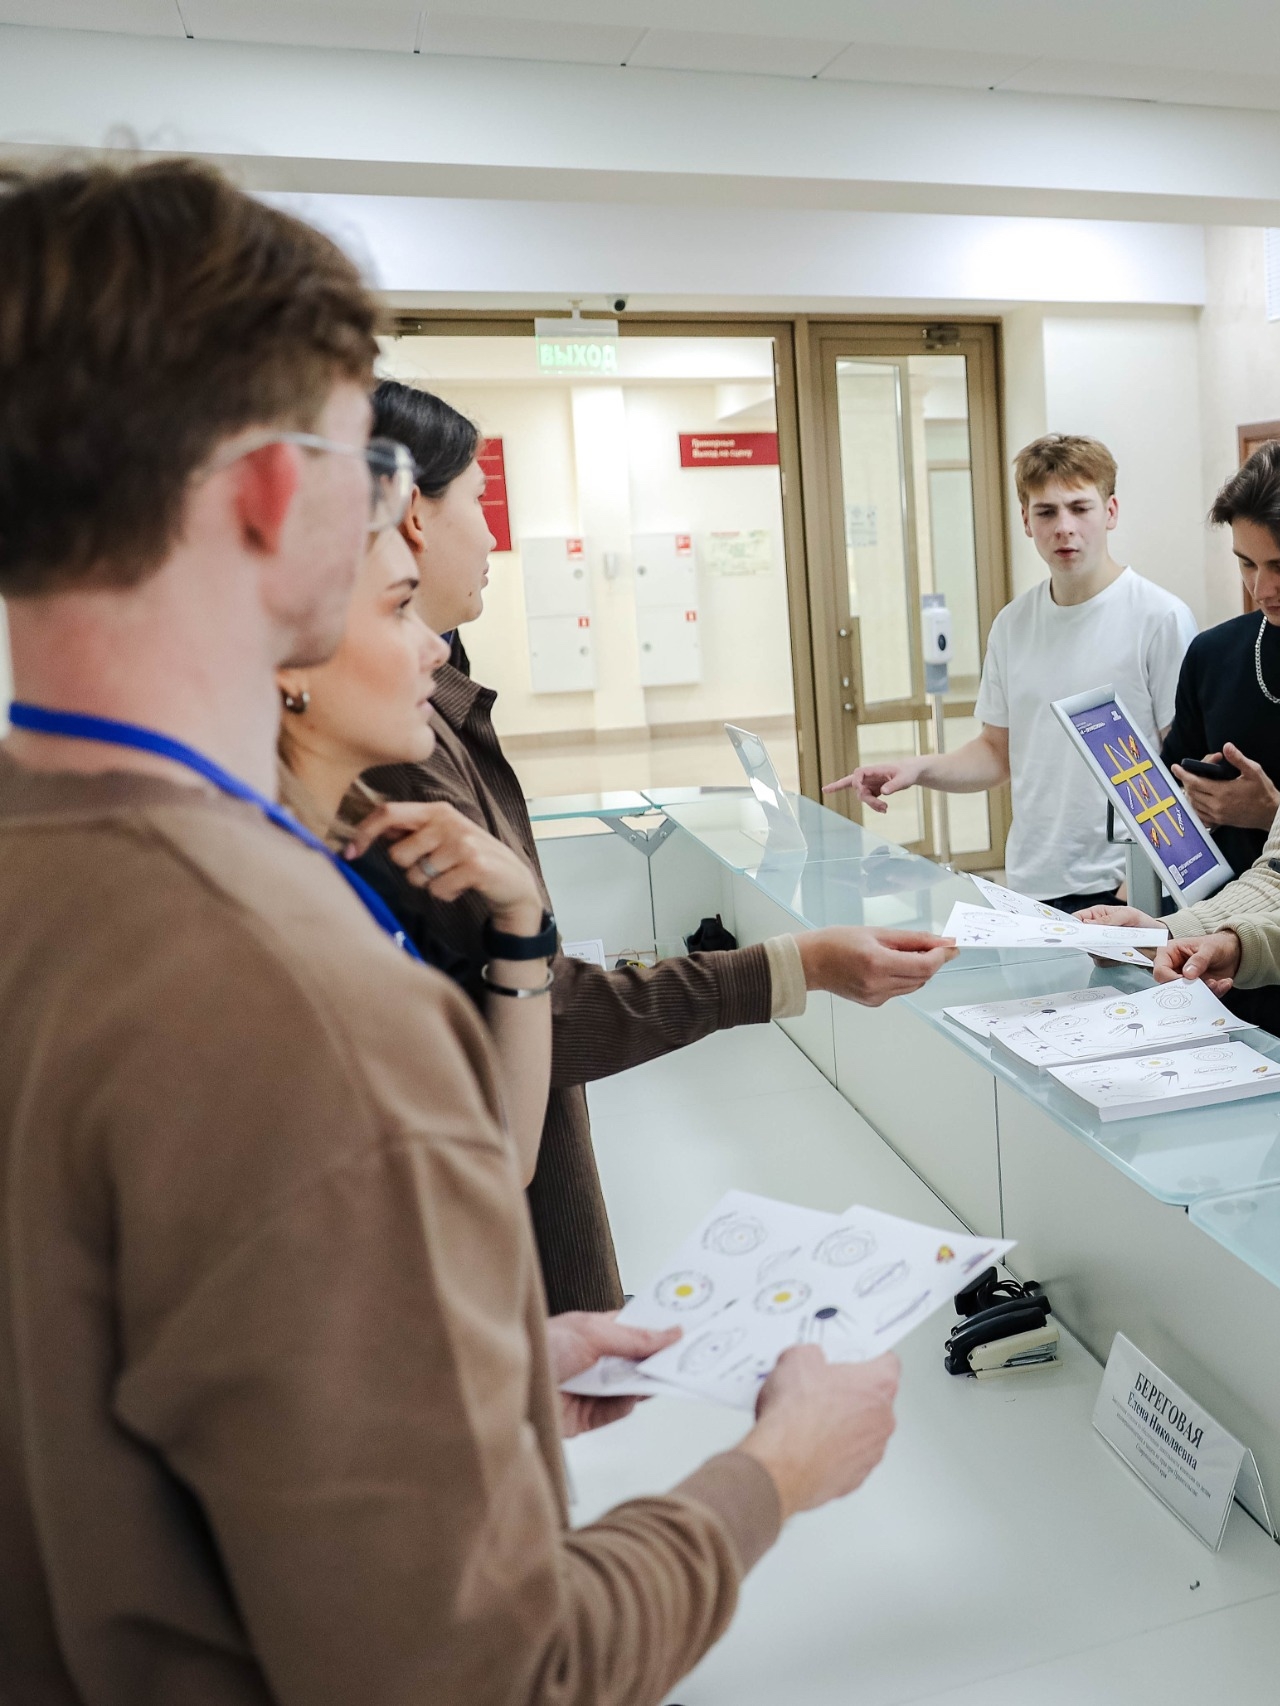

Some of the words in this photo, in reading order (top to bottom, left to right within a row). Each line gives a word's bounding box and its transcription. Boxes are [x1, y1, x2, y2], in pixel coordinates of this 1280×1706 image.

[540, 343, 618, 371] ВЫХОД
[1127, 1391, 1149, 1422] Елена
[1149, 1413, 1198, 1471] Николаевна
[1134, 1371, 1204, 1449] БЕРЕГОВАЯ
